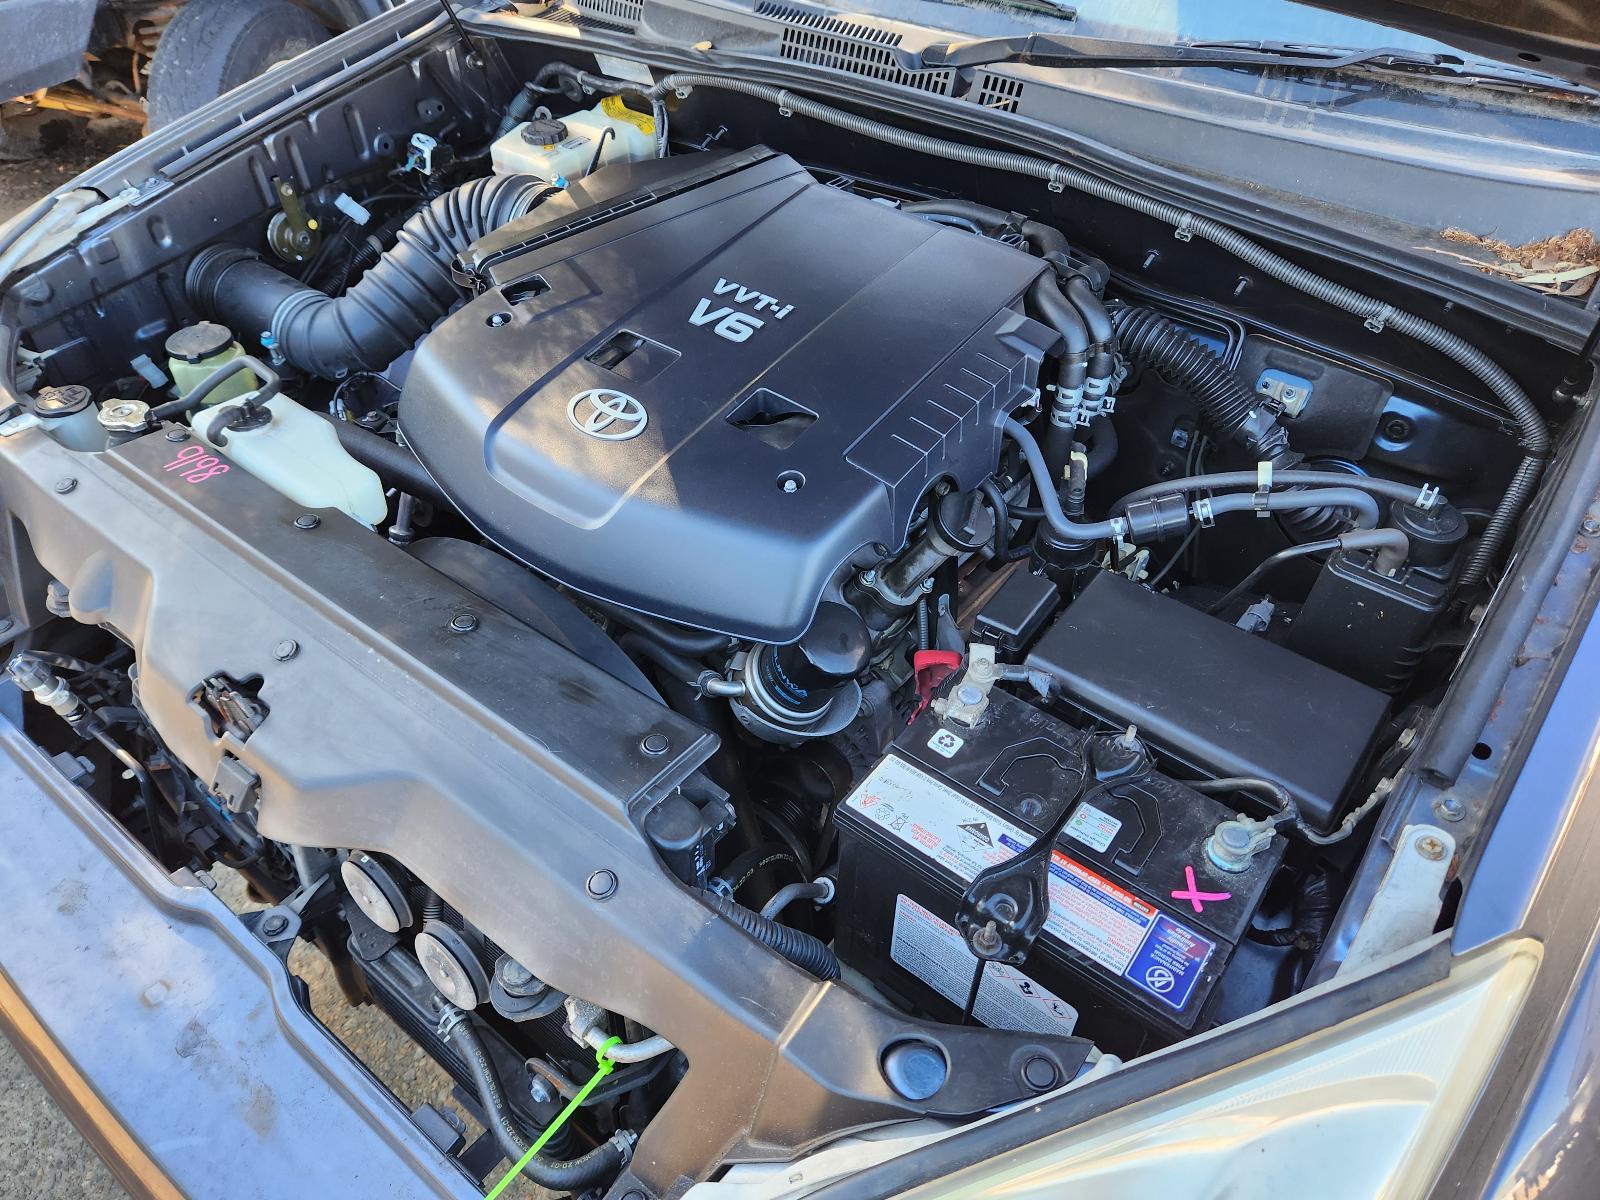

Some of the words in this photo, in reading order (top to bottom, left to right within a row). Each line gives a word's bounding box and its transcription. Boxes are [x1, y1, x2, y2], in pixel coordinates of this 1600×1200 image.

[687, 297, 766, 343] V6
[1165, 927, 1195, 948] Australian
[1149, 952, 1185, 976] MAINTENANCE
[1153, 949, 1172, 963] DESIGN
[1171, 959, 1185, 970] FREE
